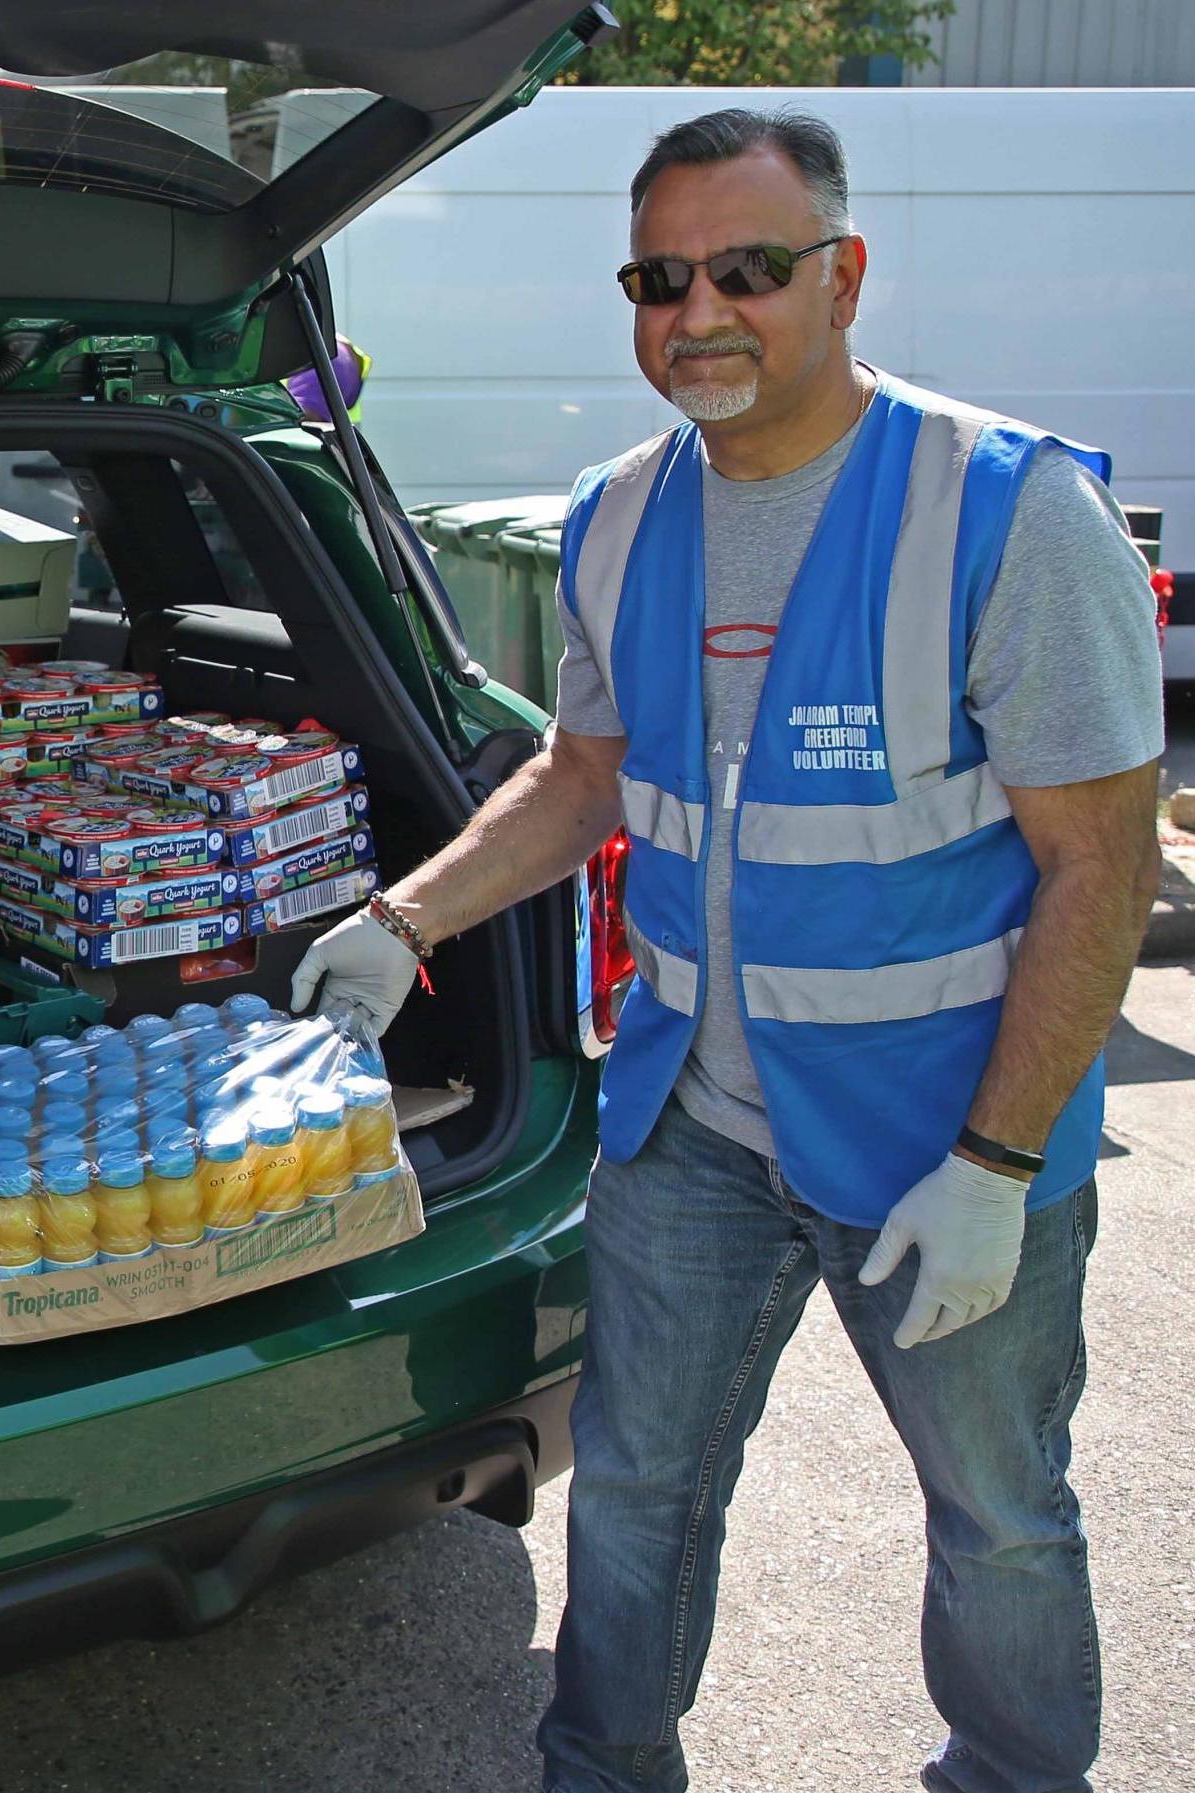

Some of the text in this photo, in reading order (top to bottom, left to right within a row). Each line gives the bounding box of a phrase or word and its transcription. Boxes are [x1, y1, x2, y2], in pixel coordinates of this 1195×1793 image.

[39, 703, 86, 718] Quark Yogurt
[788, 705, 839, 726] JALARAM
[804, 727, 867, 749] GREENFORD
[792, 750, 887, 771] VOLUNTEER
[149, 842, 175, 857] Quark
[175, 840, 201, 857] Yogurt
[298, 853, 322, 870] Quark
[323, 844, 346, 864] Yogurt
[164, 886, 190, 901] Quark
[190, 883, 216, 900] Yogurt
[106, 1270, 141, 1288] WRIN
[130, 1275, 185, 1299] SMOOTH
[3, 1285, 100, 1317] Tropicana
